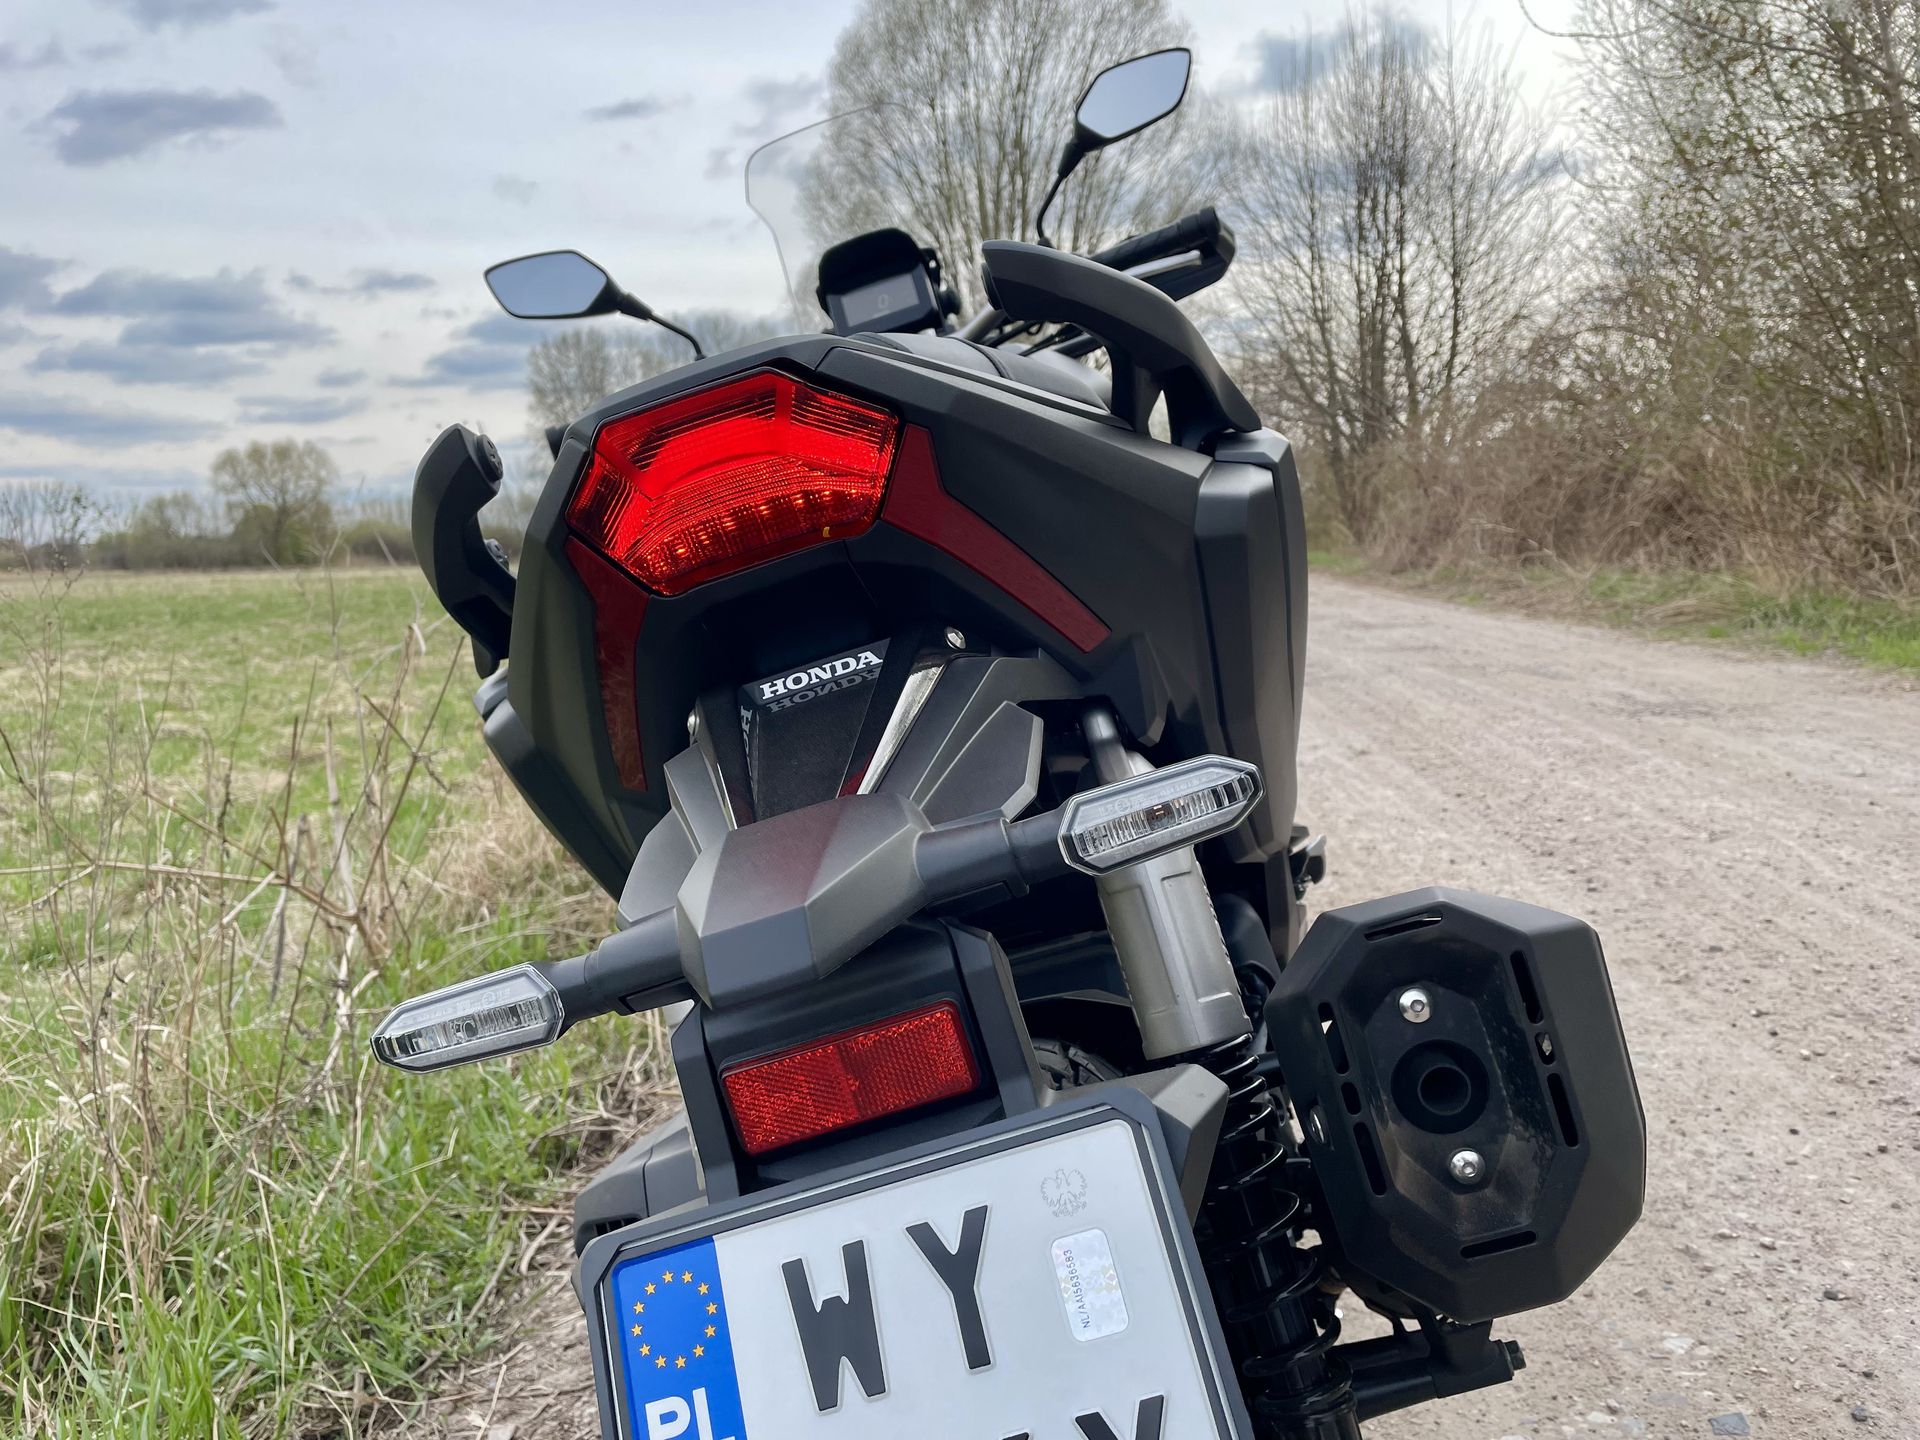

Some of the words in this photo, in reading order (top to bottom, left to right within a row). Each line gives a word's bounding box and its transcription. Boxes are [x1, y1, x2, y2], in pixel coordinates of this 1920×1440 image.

[760, 651, 883, 700] HONDA
[782, 1205, 991, 1411] WY
[645, 1387, 735, 1440] PL
